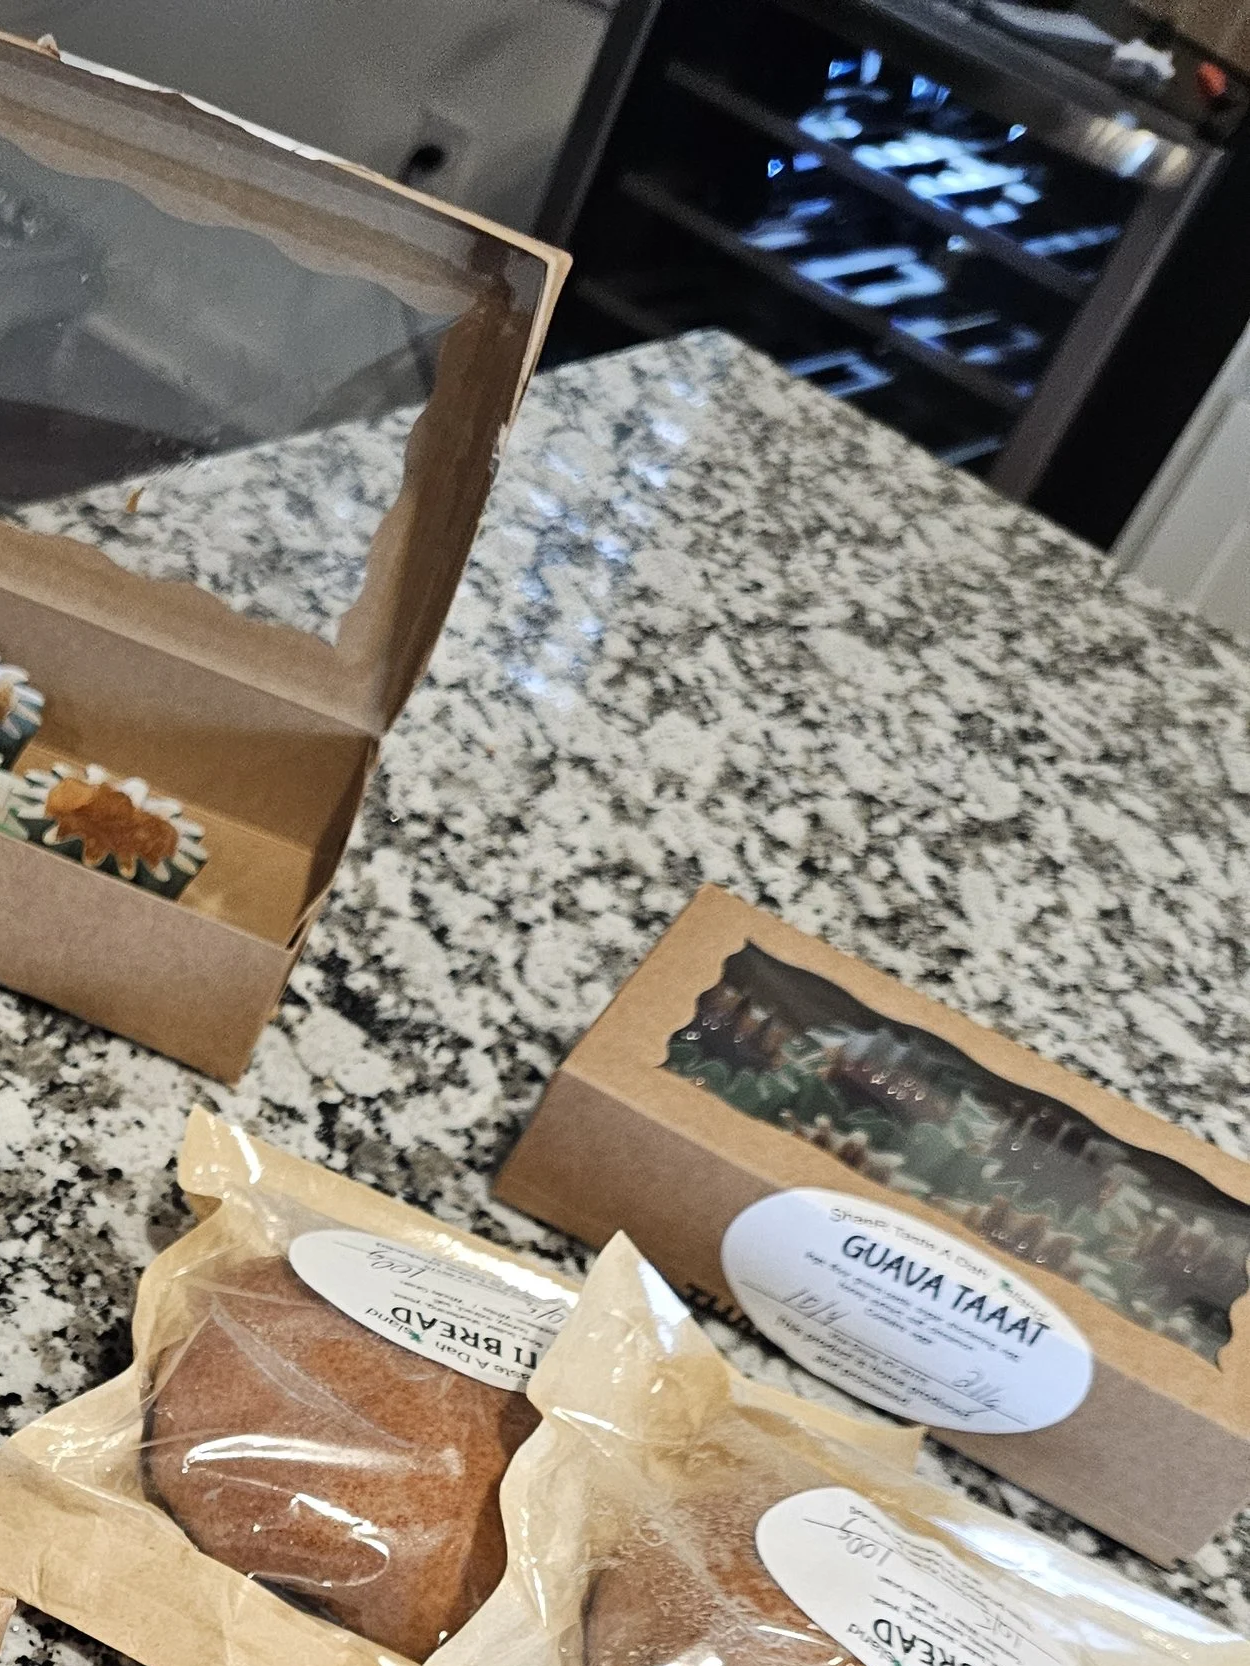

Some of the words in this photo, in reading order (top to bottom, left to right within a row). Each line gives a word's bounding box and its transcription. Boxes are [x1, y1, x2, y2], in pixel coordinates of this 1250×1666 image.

[842, 1233, 946, 1302] GUAVA
[953, 1283, 1051, 1346] TAAAT
[391, 1306, 502, 1359] BREAD
[435, 1340, 471, 1364] Dah
[476, 1357, 490, 1370] A
